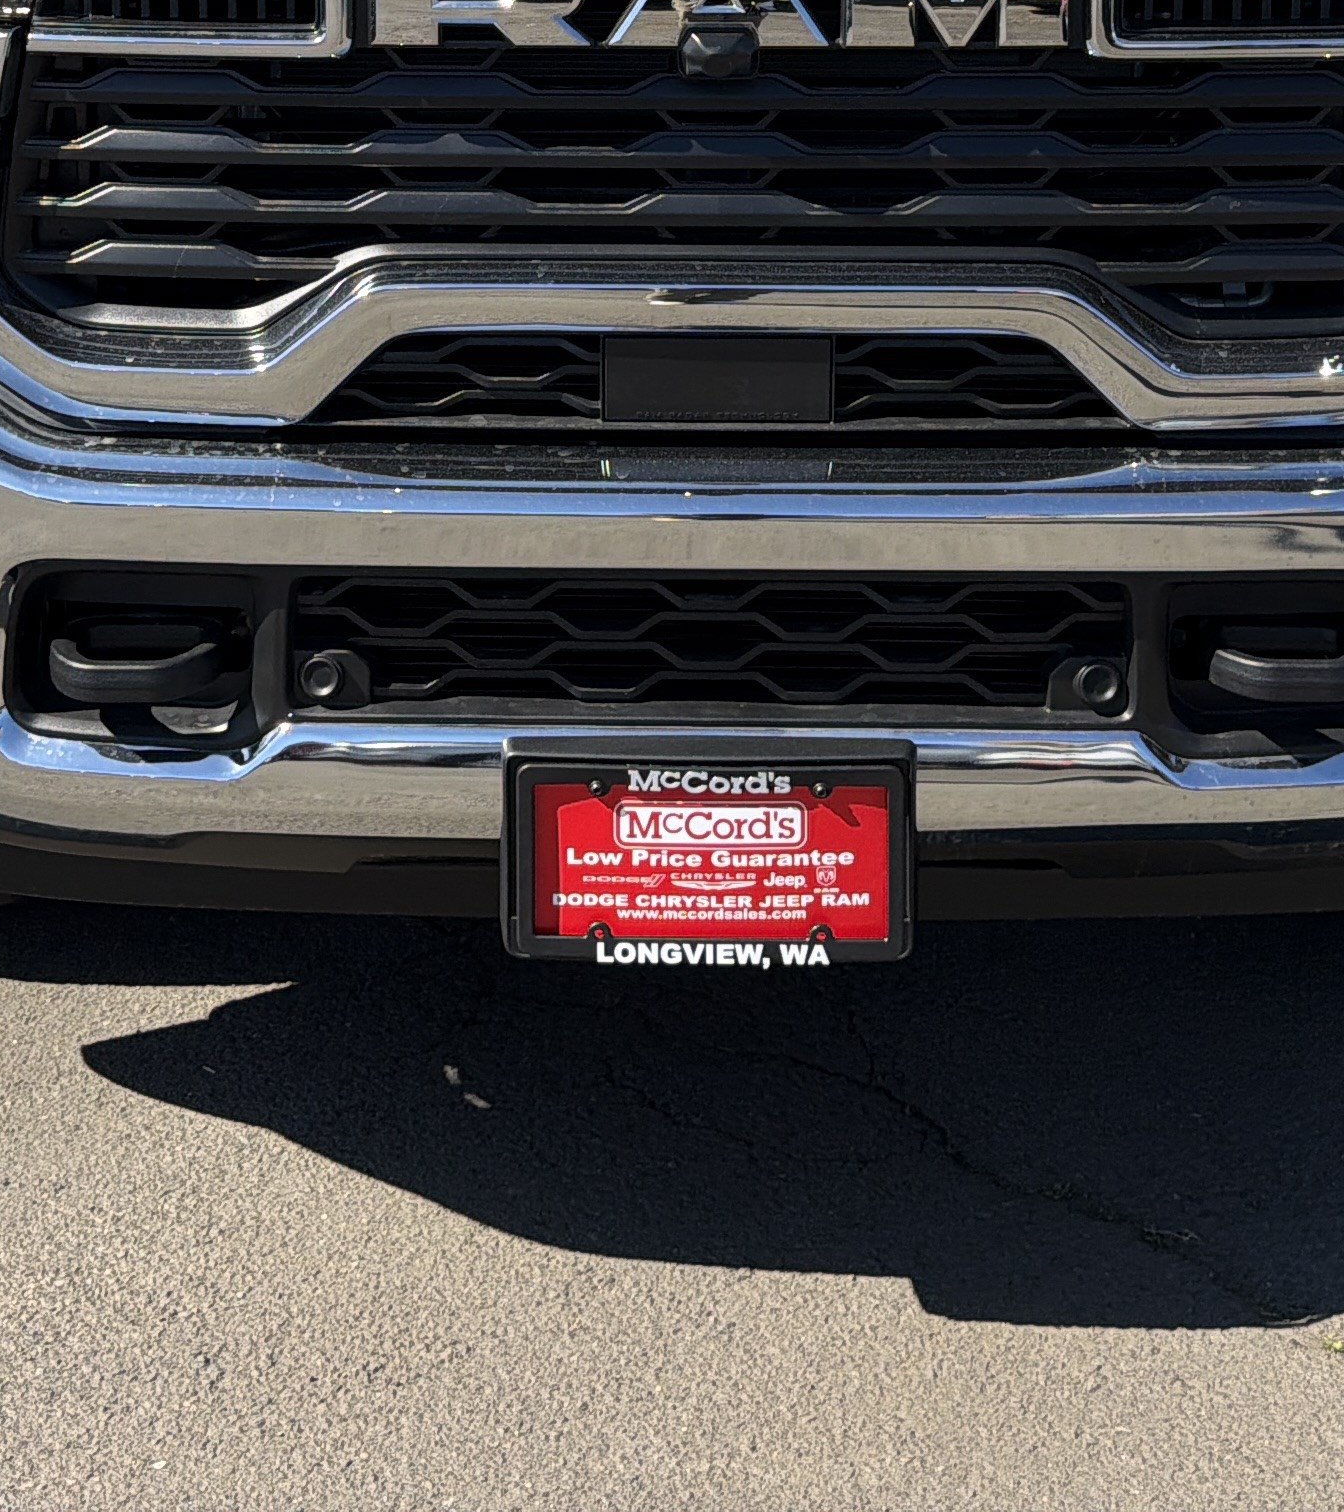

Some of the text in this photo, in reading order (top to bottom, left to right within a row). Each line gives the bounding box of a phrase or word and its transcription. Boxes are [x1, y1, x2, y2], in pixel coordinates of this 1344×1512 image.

[627, 769, 792, 795] McCord's
[625, 810, 796, 840] McCord's
[566, 847, 855, 868] Low Price Guarantee
[669, 872, 757, 880] CHRYSLER
[762, 871, 806, 889] Jeep
[552, 892, 870, 908] DODGE CHRYSLER JEEP RAM
[616, 908, 807, 921] www.mccordsales.com
[596, 941, 831, 970] LONGVIEW, WA
